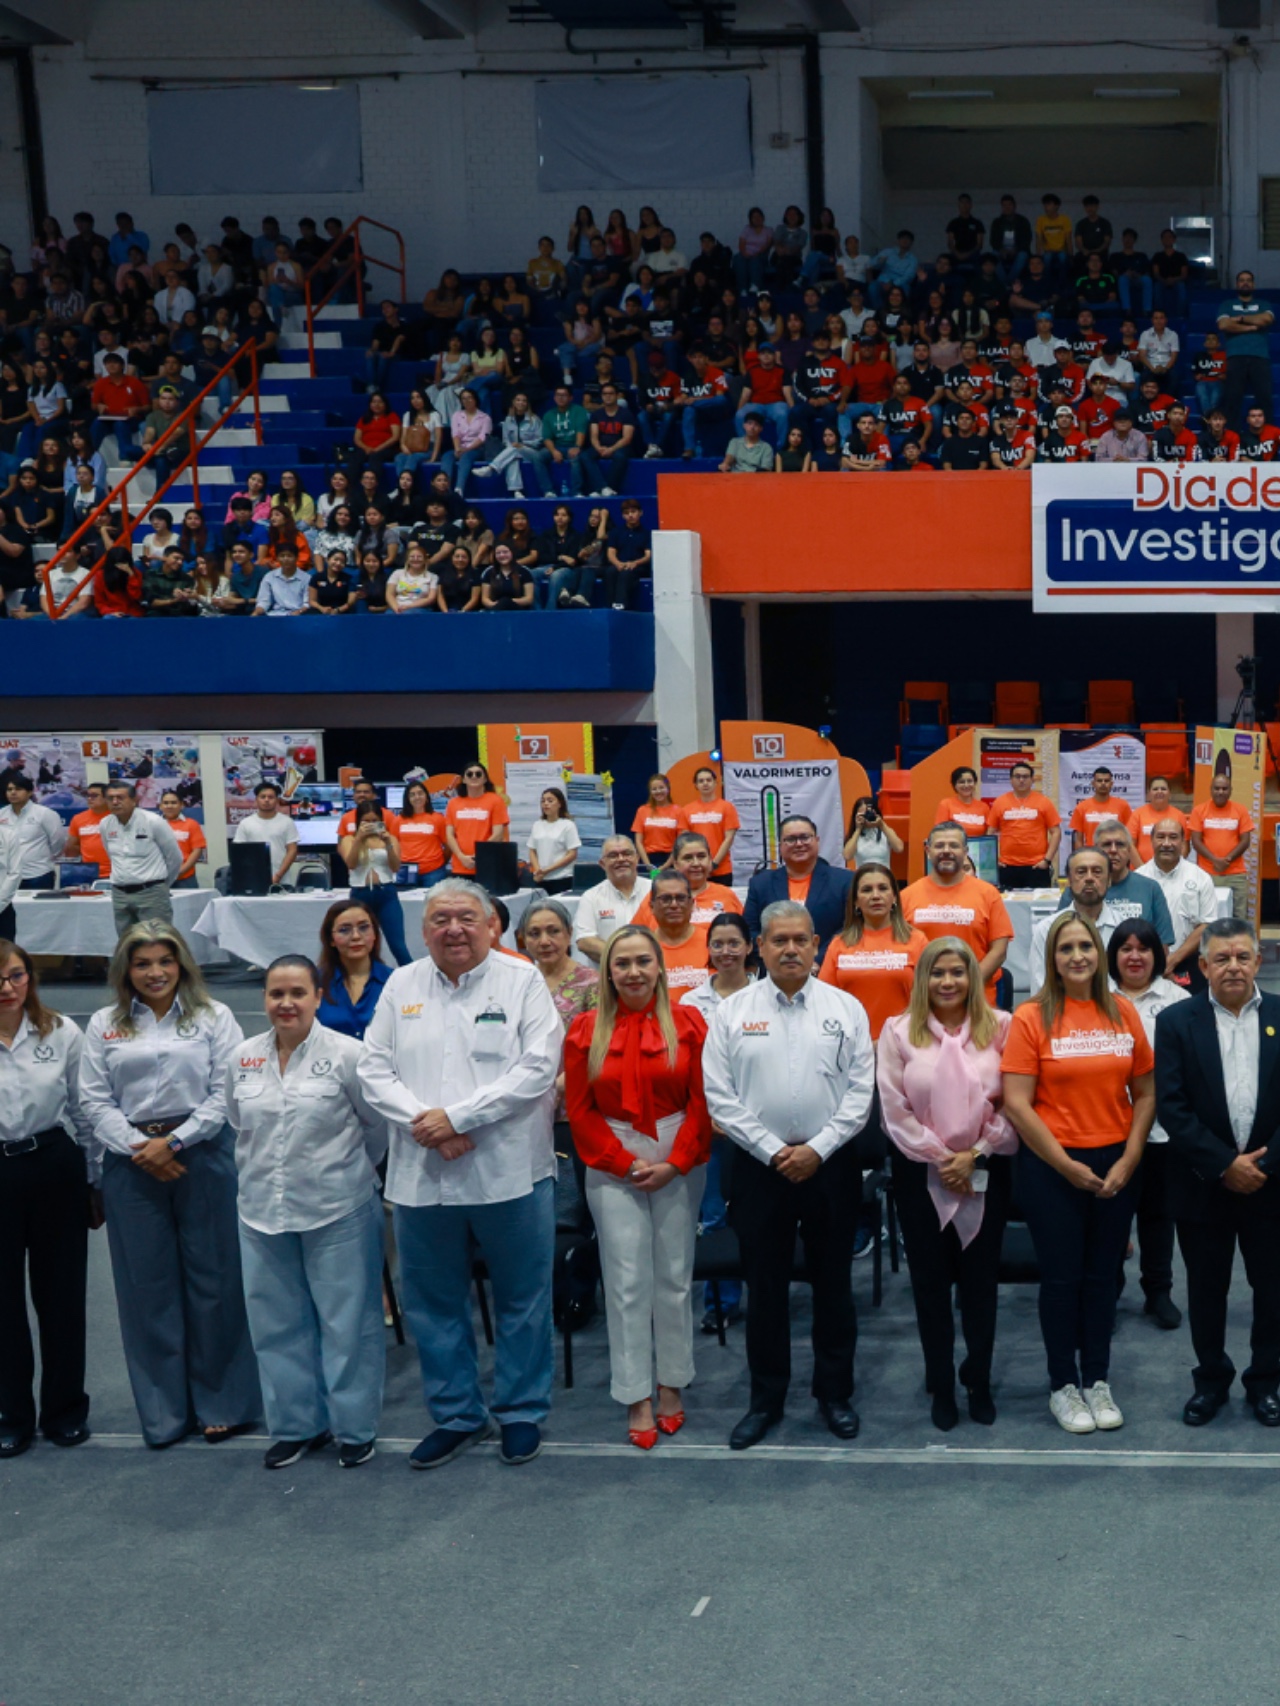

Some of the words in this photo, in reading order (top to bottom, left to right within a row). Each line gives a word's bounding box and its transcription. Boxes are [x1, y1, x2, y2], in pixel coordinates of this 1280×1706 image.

[91, 741, 102, 756] 8
[530, 740, 540, 754] 9
[757, 737, 780, 753] 10
[733, 766, 832, 778] VALORIMETRO
[742, 1021, 770, 1031] UAT
[240, 1057, 267, 1068] UAT
